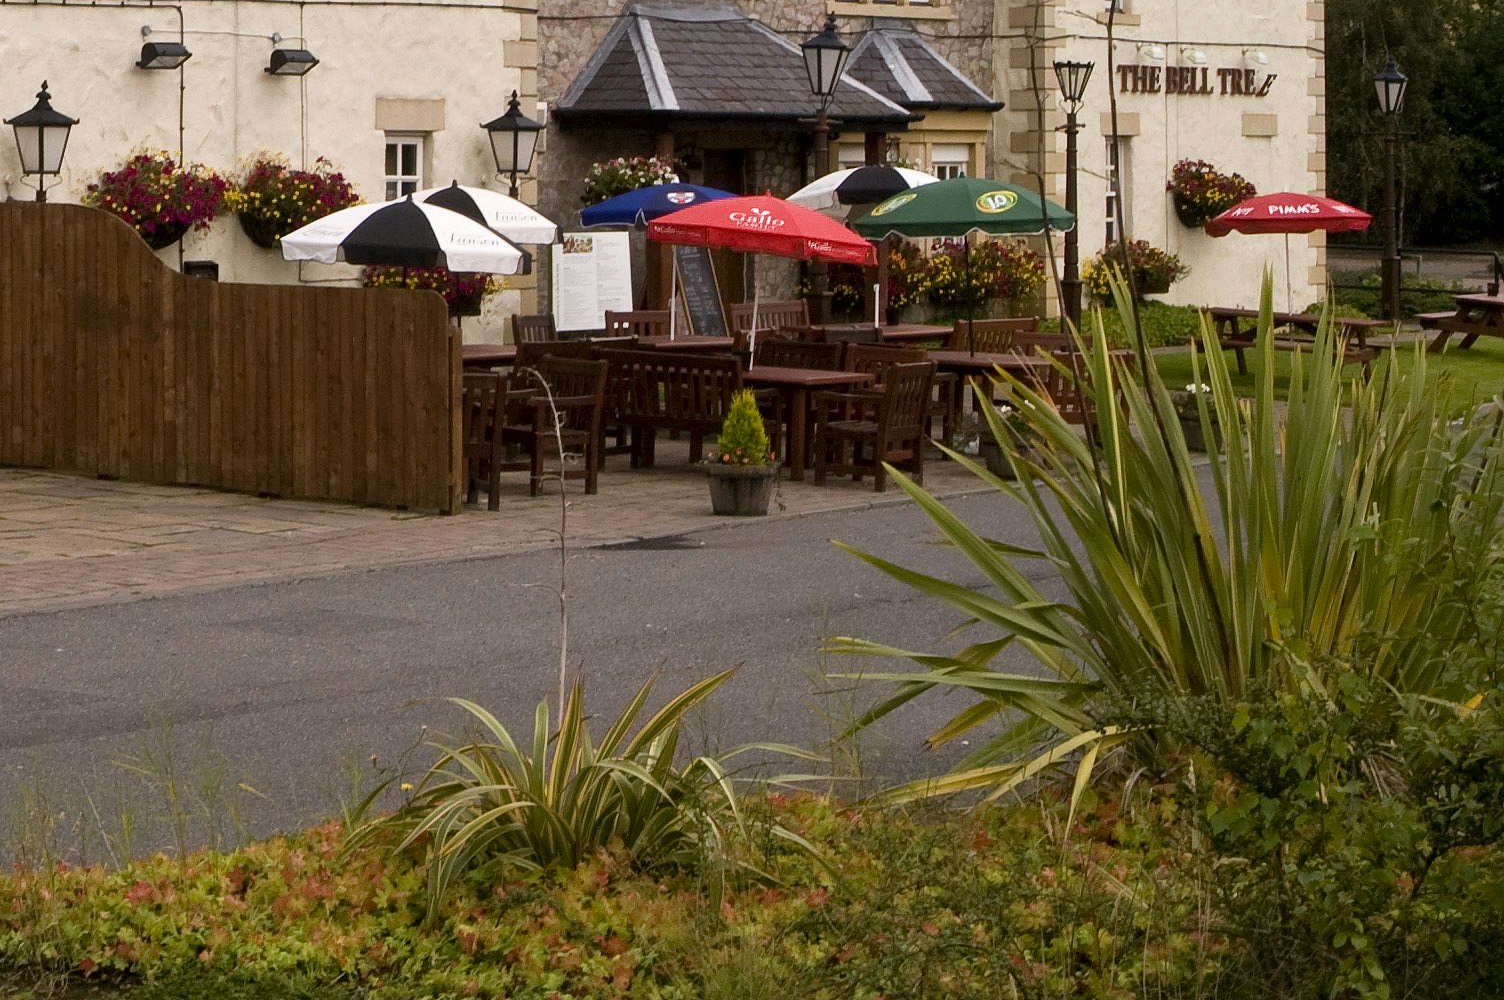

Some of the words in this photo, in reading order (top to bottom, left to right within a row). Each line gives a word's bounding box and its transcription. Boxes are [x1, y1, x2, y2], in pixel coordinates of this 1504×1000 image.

[1116, 64, 1162, 93] THE
[1165, 66, 1214, 95] BELL
[1216, 67, 1277, 97] TREE
[1268, 202, 1320, 215] PIMM'S
[729, 210, 785, 227] Gallo
